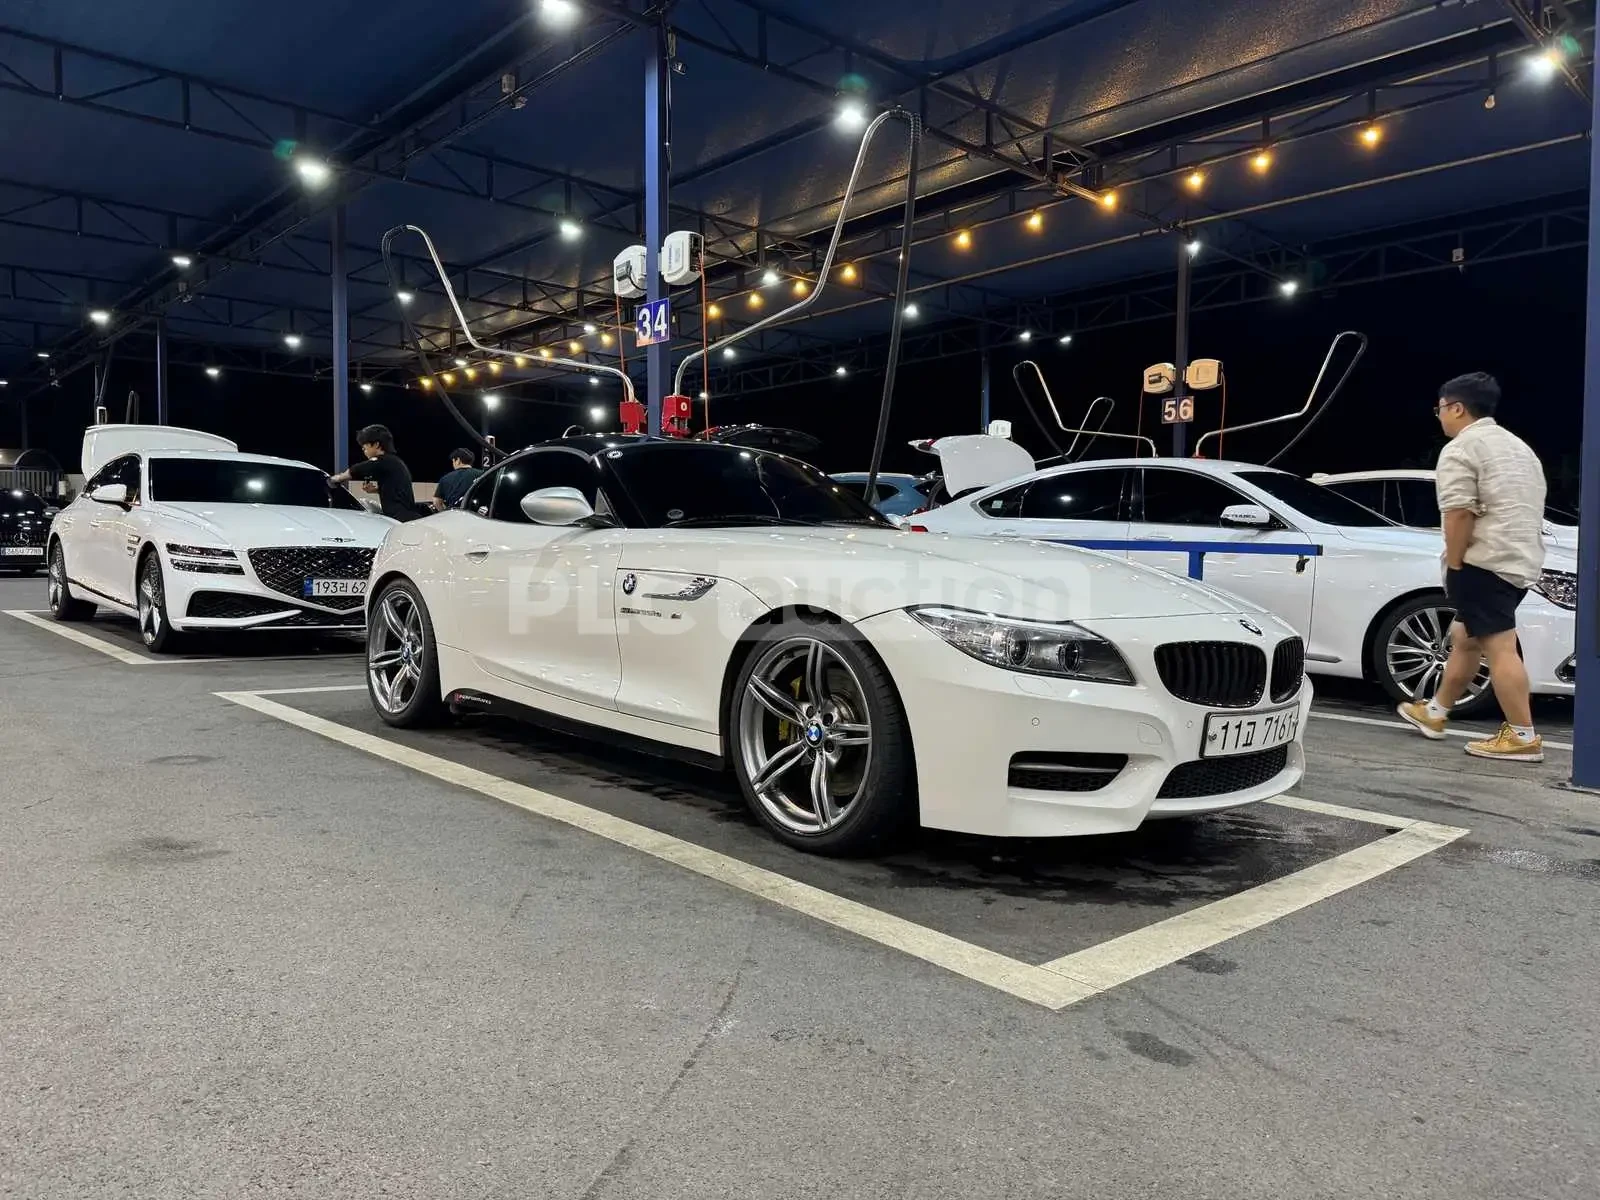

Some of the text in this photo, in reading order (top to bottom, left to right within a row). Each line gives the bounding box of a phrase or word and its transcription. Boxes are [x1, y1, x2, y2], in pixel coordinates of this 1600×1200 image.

[639, 304, 667, 339] 34
[1164, 399, 1192, 420] 56
[352, 581, 367, 594] 62
[1262, 712, 1293, 745] 7161
